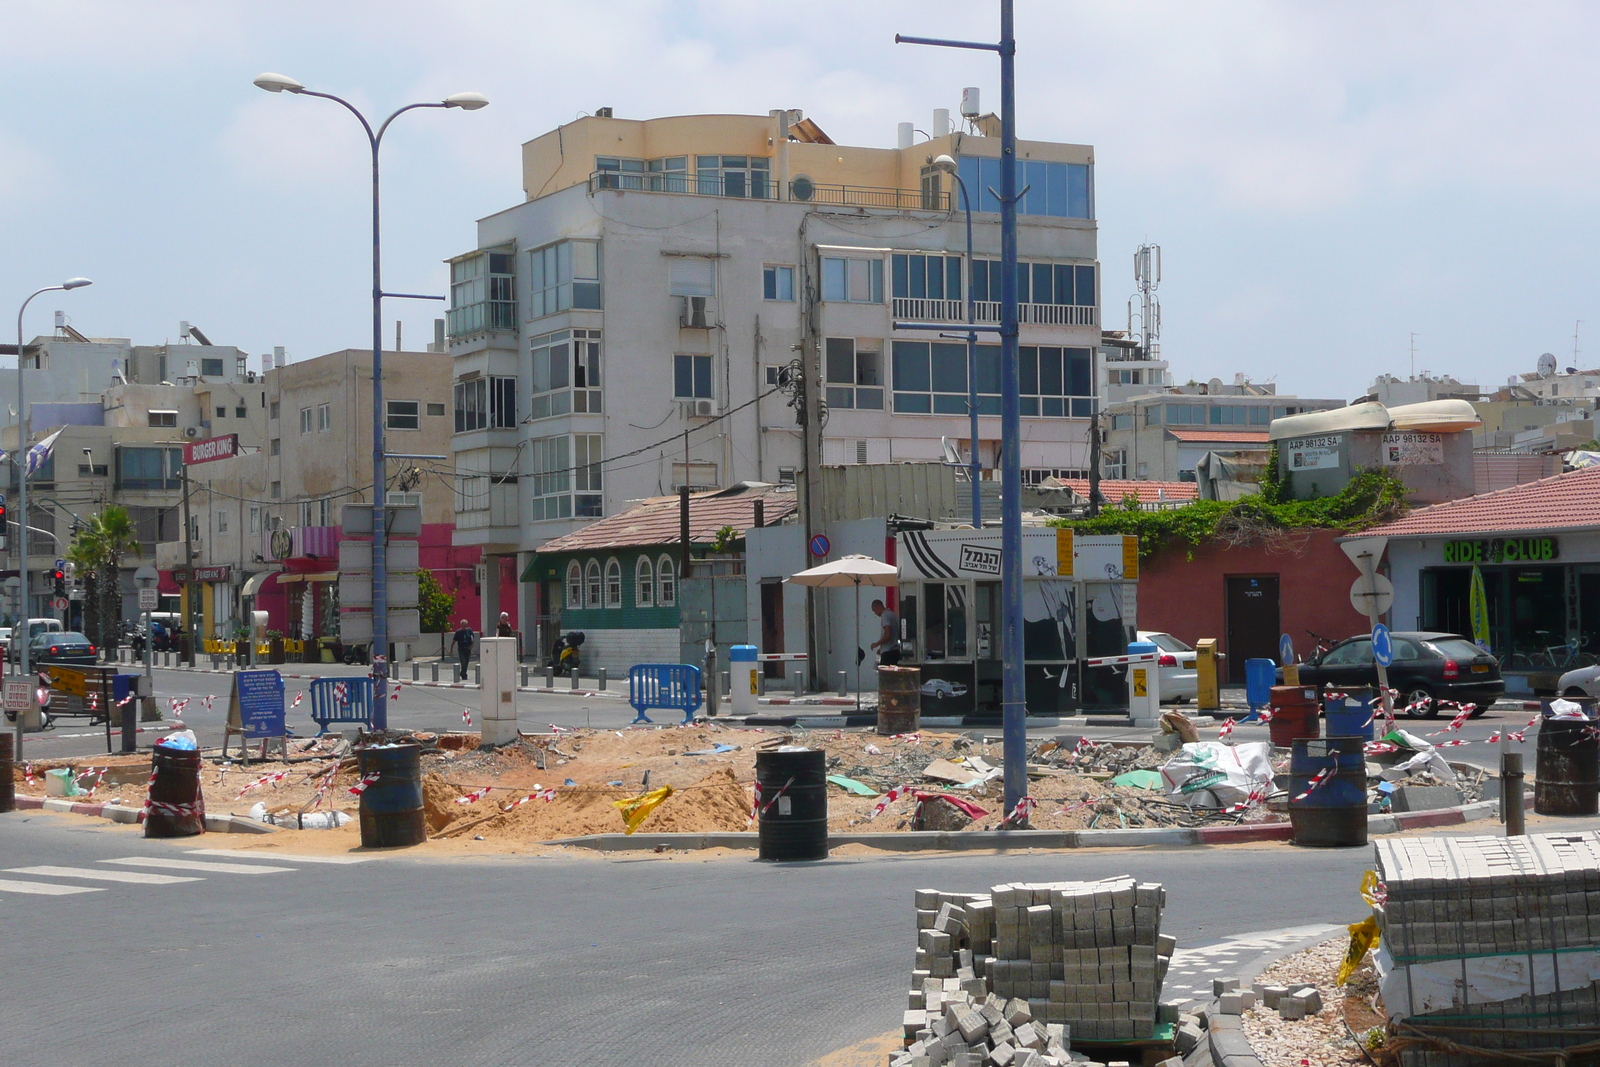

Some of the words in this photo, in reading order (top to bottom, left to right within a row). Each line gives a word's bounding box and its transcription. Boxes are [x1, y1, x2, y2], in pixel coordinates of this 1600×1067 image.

[1289, 441, 1304, 449] AAP
[1305, 438, 1326, 448] 98132
[1327, 436, 1338, 446] SA
[1382, 435, 1400, 443] AAP
[1402, 434, 1427, 443] 98132
[1429, 434, 1441, 443] SA
[192, 441, 216, 461] BURGER
[216, 438, 232, 456] KING
[964, 548, 999, 564] הנמל
[1443, 541, 1482, 562] RIDE
[1503, 539, 1553, 560] CLUB
